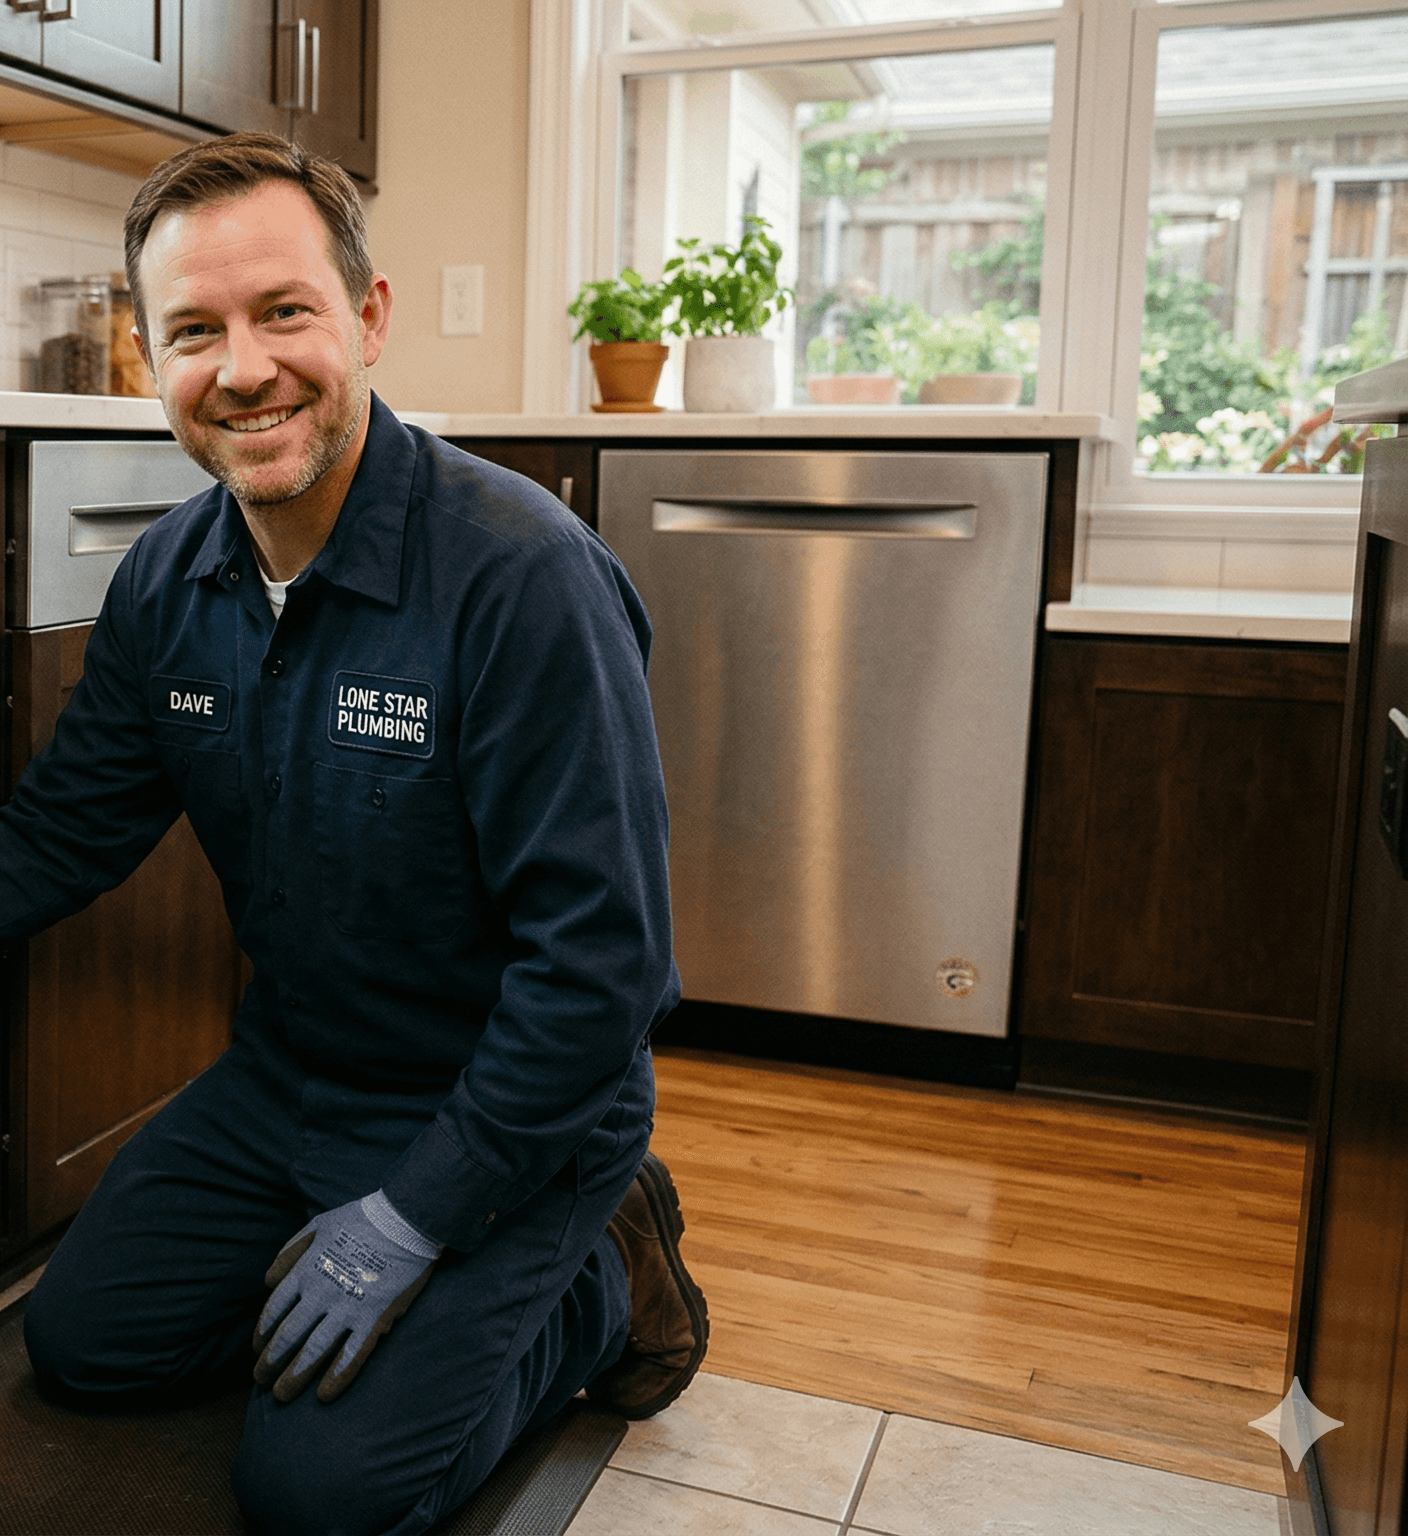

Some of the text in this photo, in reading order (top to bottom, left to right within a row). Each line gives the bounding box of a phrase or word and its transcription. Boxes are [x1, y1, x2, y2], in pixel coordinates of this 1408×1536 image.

[170, 691, 215, 716] DAVE
[337, 685, 429, 720] LONE STAR
[337, 709, 426, 744] PLUMBING
